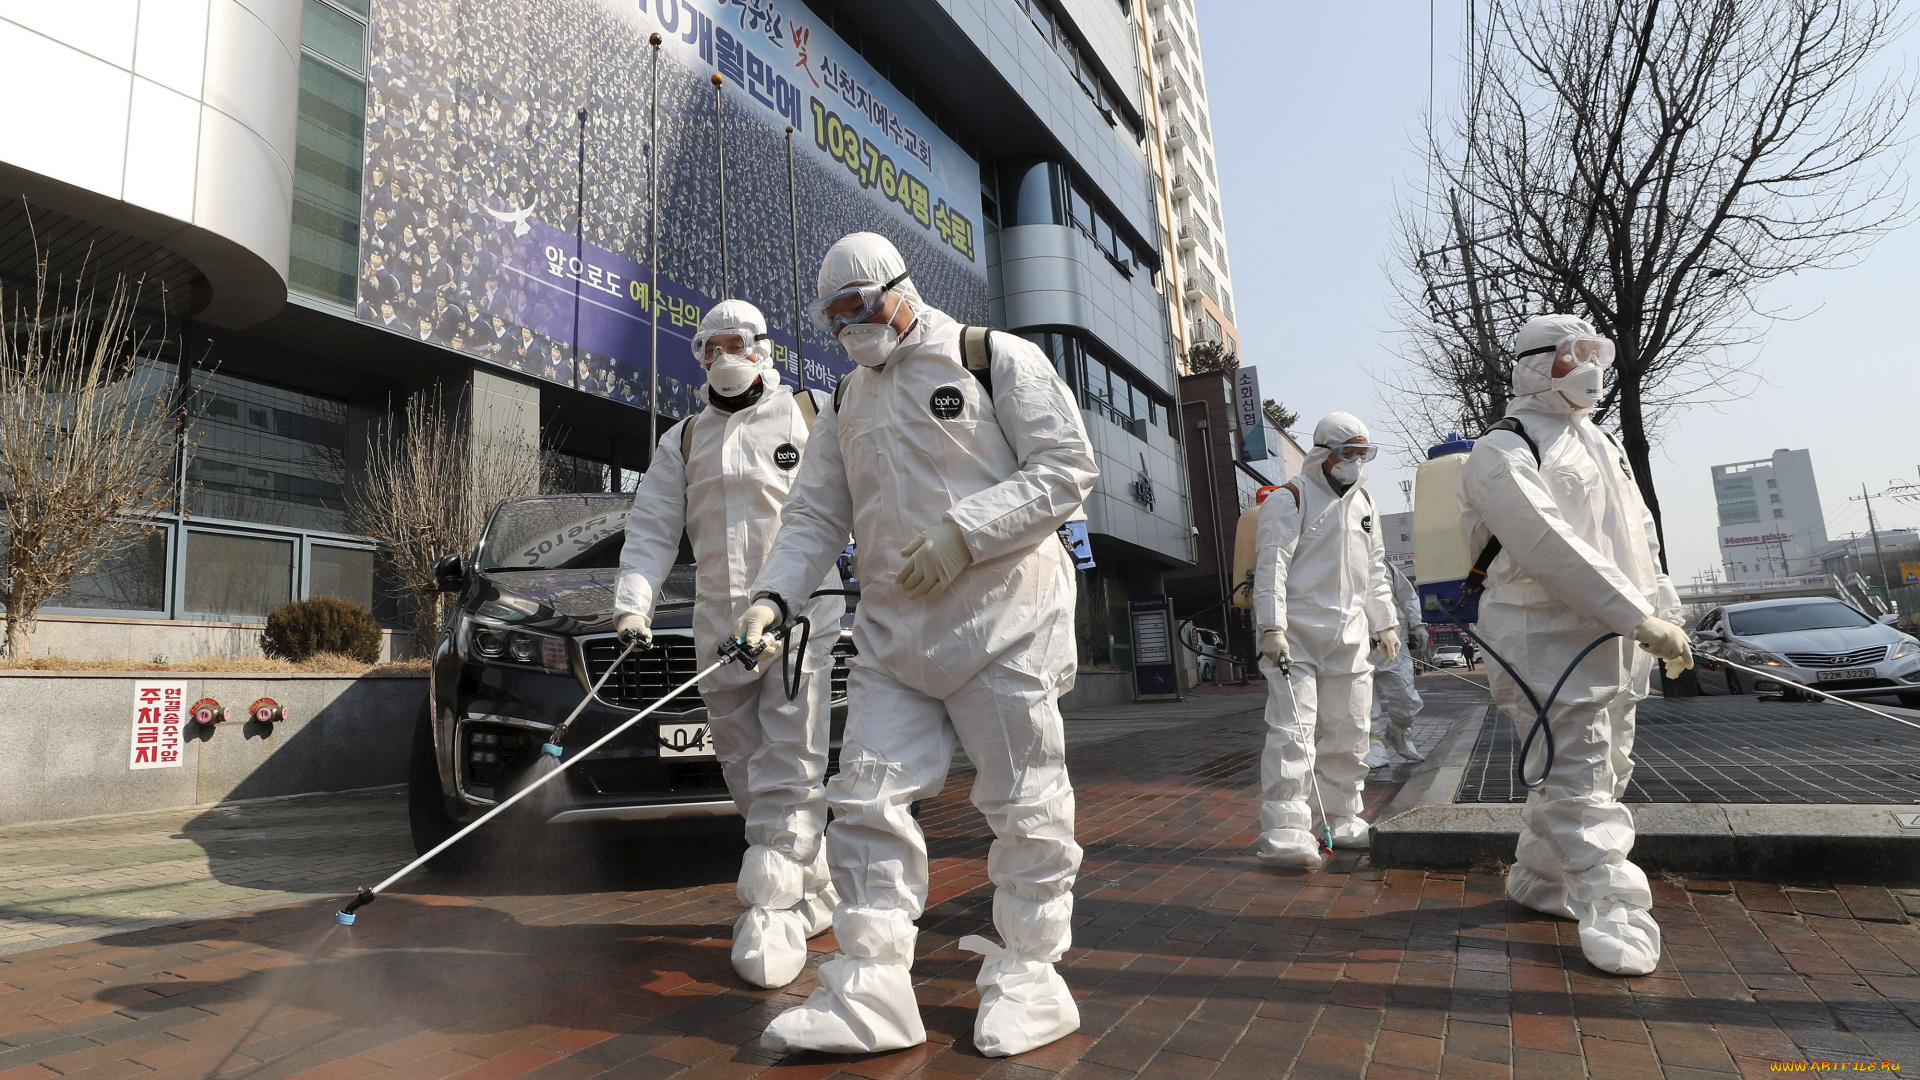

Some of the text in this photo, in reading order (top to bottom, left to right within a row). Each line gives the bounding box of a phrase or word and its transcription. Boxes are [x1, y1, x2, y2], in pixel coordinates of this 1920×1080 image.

[639, 0, 975, 262] 0개월만에 103,764명 수료!
[789, 20, 820, 88] 빛
[819, 54, 933, 173] 신천지예수교회
[545, 244, 624, 299] 앞으로도
[629, 280, 701, 333] 예수님의
[803, 357, 838, 390] 전하는
[1239, 373, 1256, 426] 소화신협
[1724, 535, 1760, 545] Home
[1846, 669, 1870, 678] 3229
[135, 688, 161, 763] 주차금지
